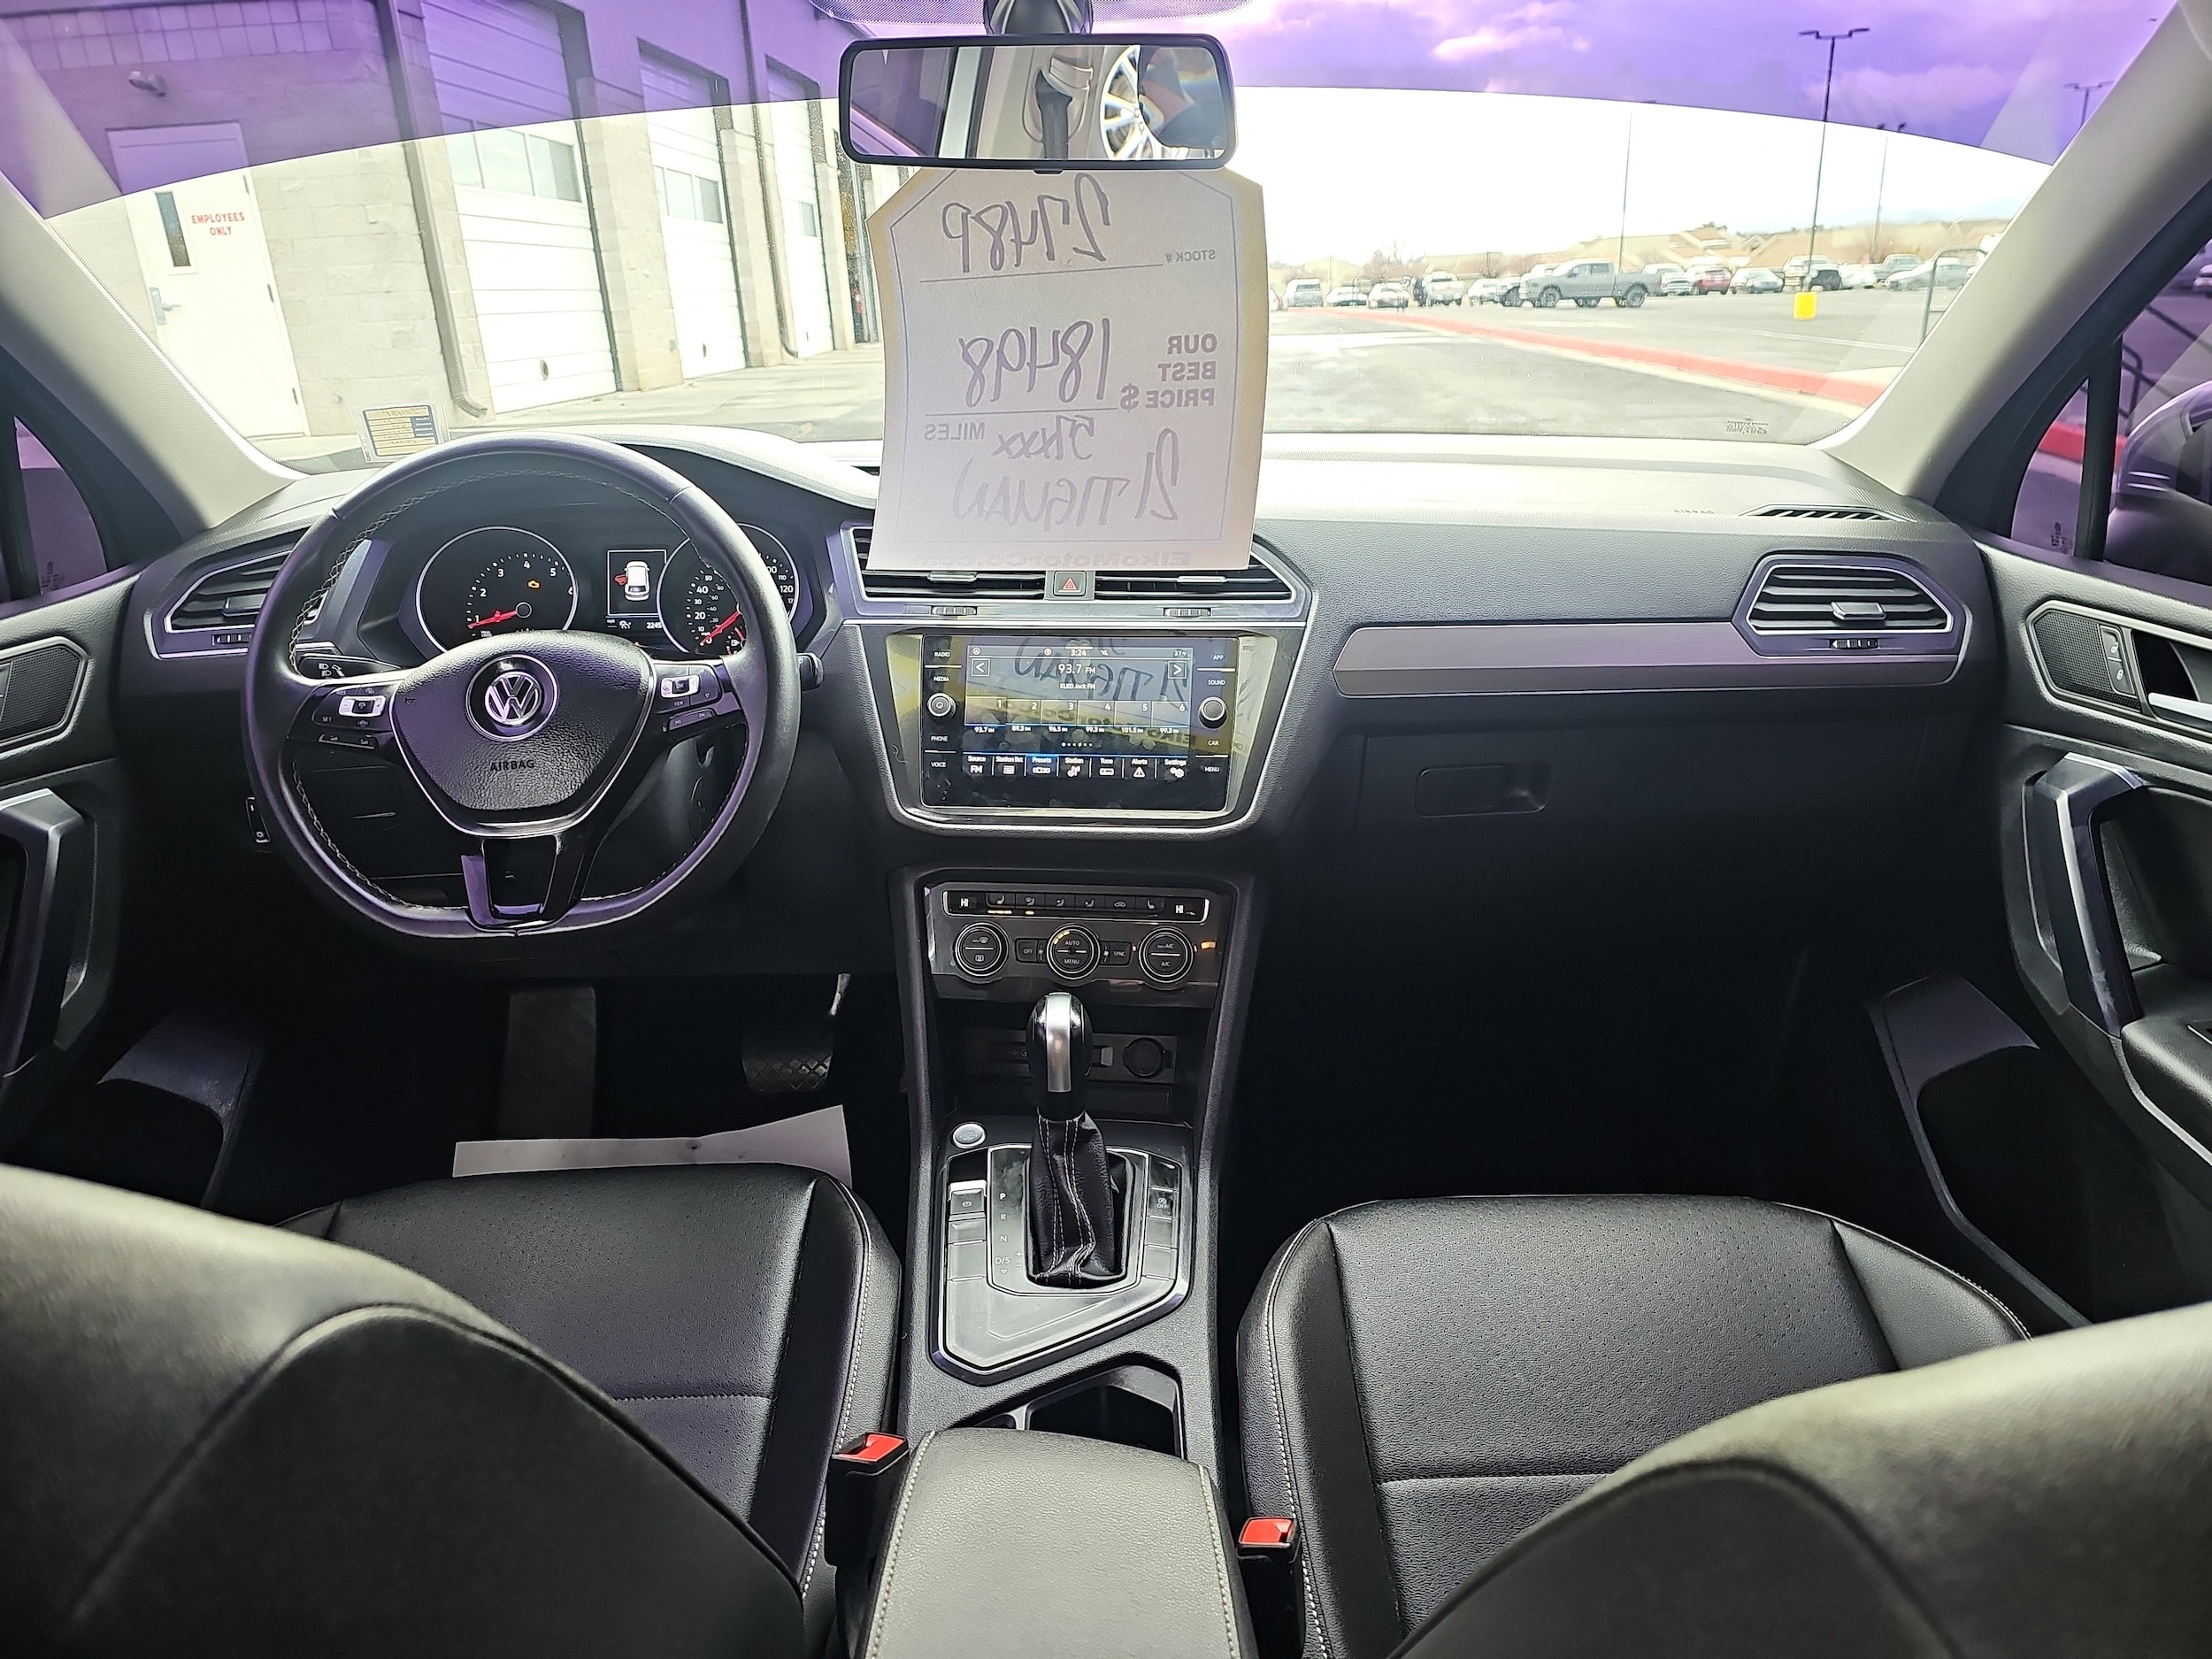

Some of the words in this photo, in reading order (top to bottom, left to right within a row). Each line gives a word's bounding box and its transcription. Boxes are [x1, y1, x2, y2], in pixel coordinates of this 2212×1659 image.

[191, 212, 245, 224] EMPLOYEES
[210, 226, 232, 235] ONLY
[523, 560, 531, 569] 4
[497, 569, 504, 578] 3
[549, 568, 557, 577] 5
[480, 588, 487, 597] 2
[696, 585, 709, 594] 40
[695, 611, 706, 620] 20
[1058, 664, 1082, 674] 93.7
[996, 700, 1002, 709] 1
[1105, 703, 1111, 711] 4
[1179, 703, 1186, 712] 6
[490, 759, 535, 772] AIRBAG
[1164, 758, 1187, 767] Settings
[970, 764, 983, 773] FM
[960, 897, 969, 907] HI
[1175, 904, 1184, 914] HI
[995, 1256, 1010, 1265] D/S
